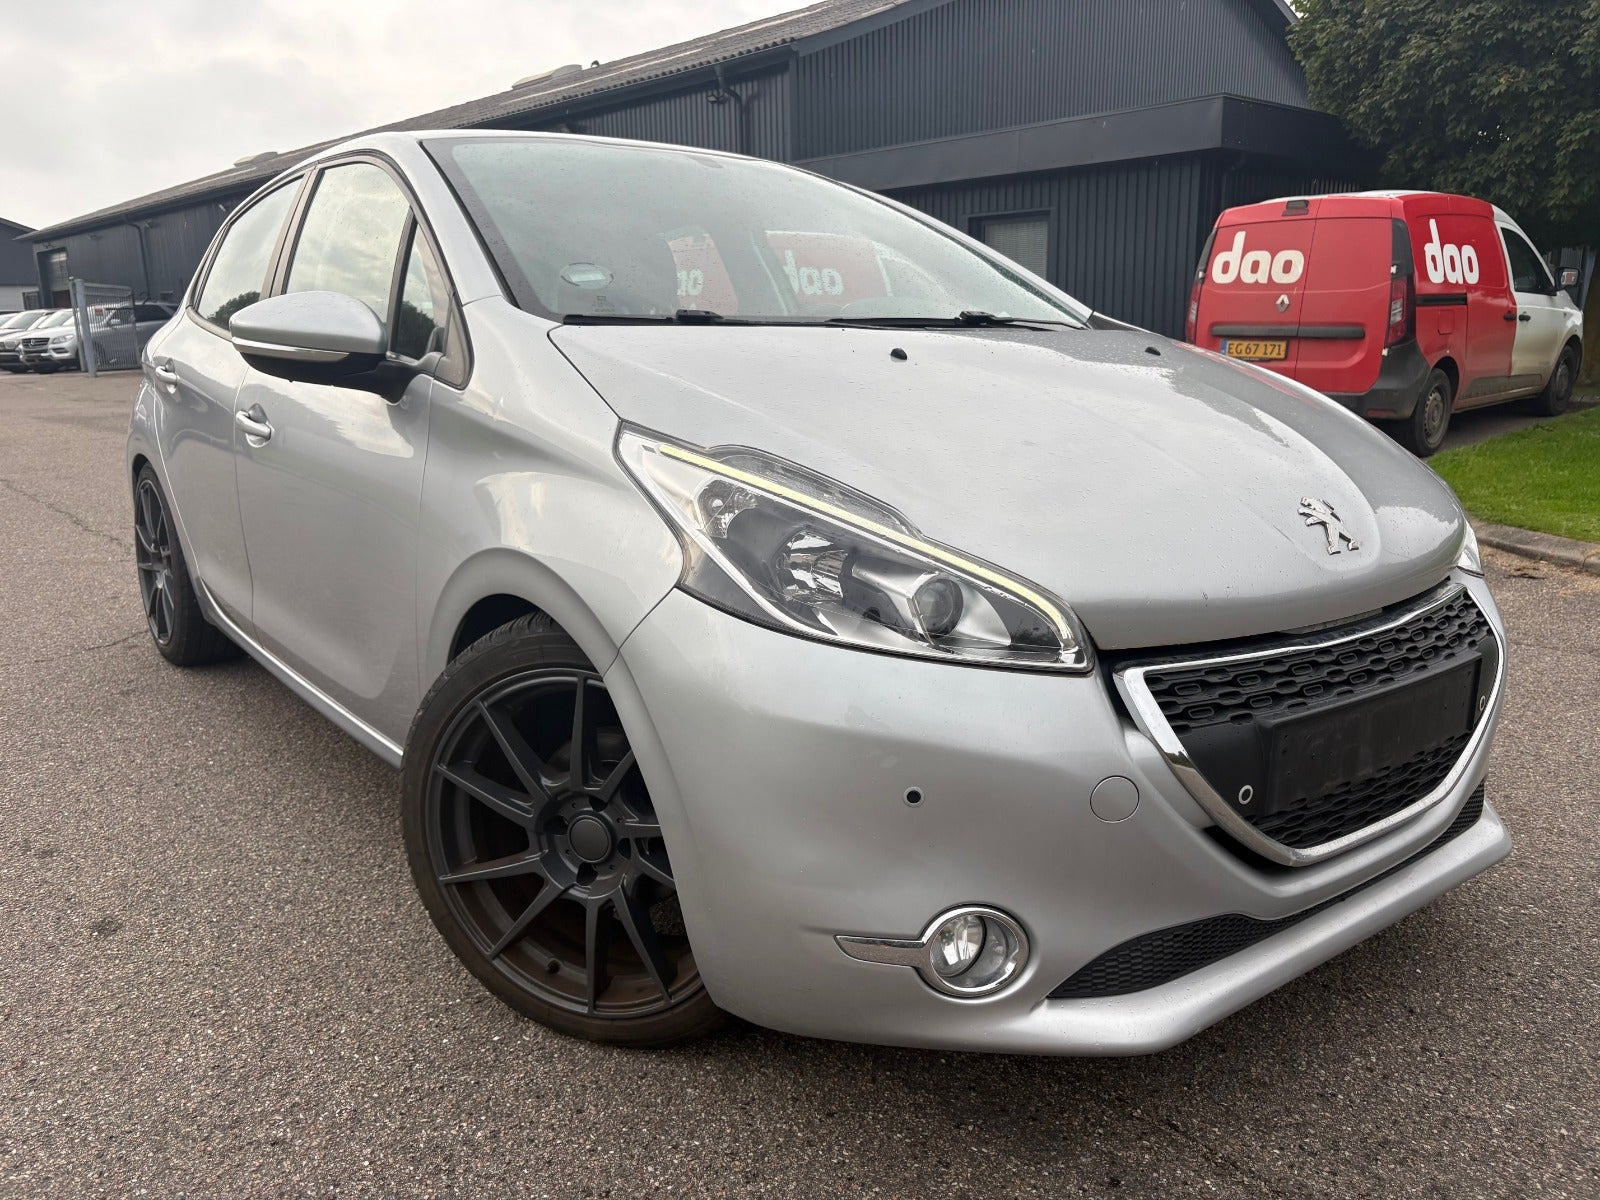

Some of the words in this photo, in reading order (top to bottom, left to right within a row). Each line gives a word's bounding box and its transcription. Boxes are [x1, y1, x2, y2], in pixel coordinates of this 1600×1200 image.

[1212, 231, 1304, 284] dao
[1424, 218, 1479, 284] dao
[1227, 343, 1243, 354] EG
[1245, 343, 1260, 355] 67
[1263, 344, 1282, 356] 171
